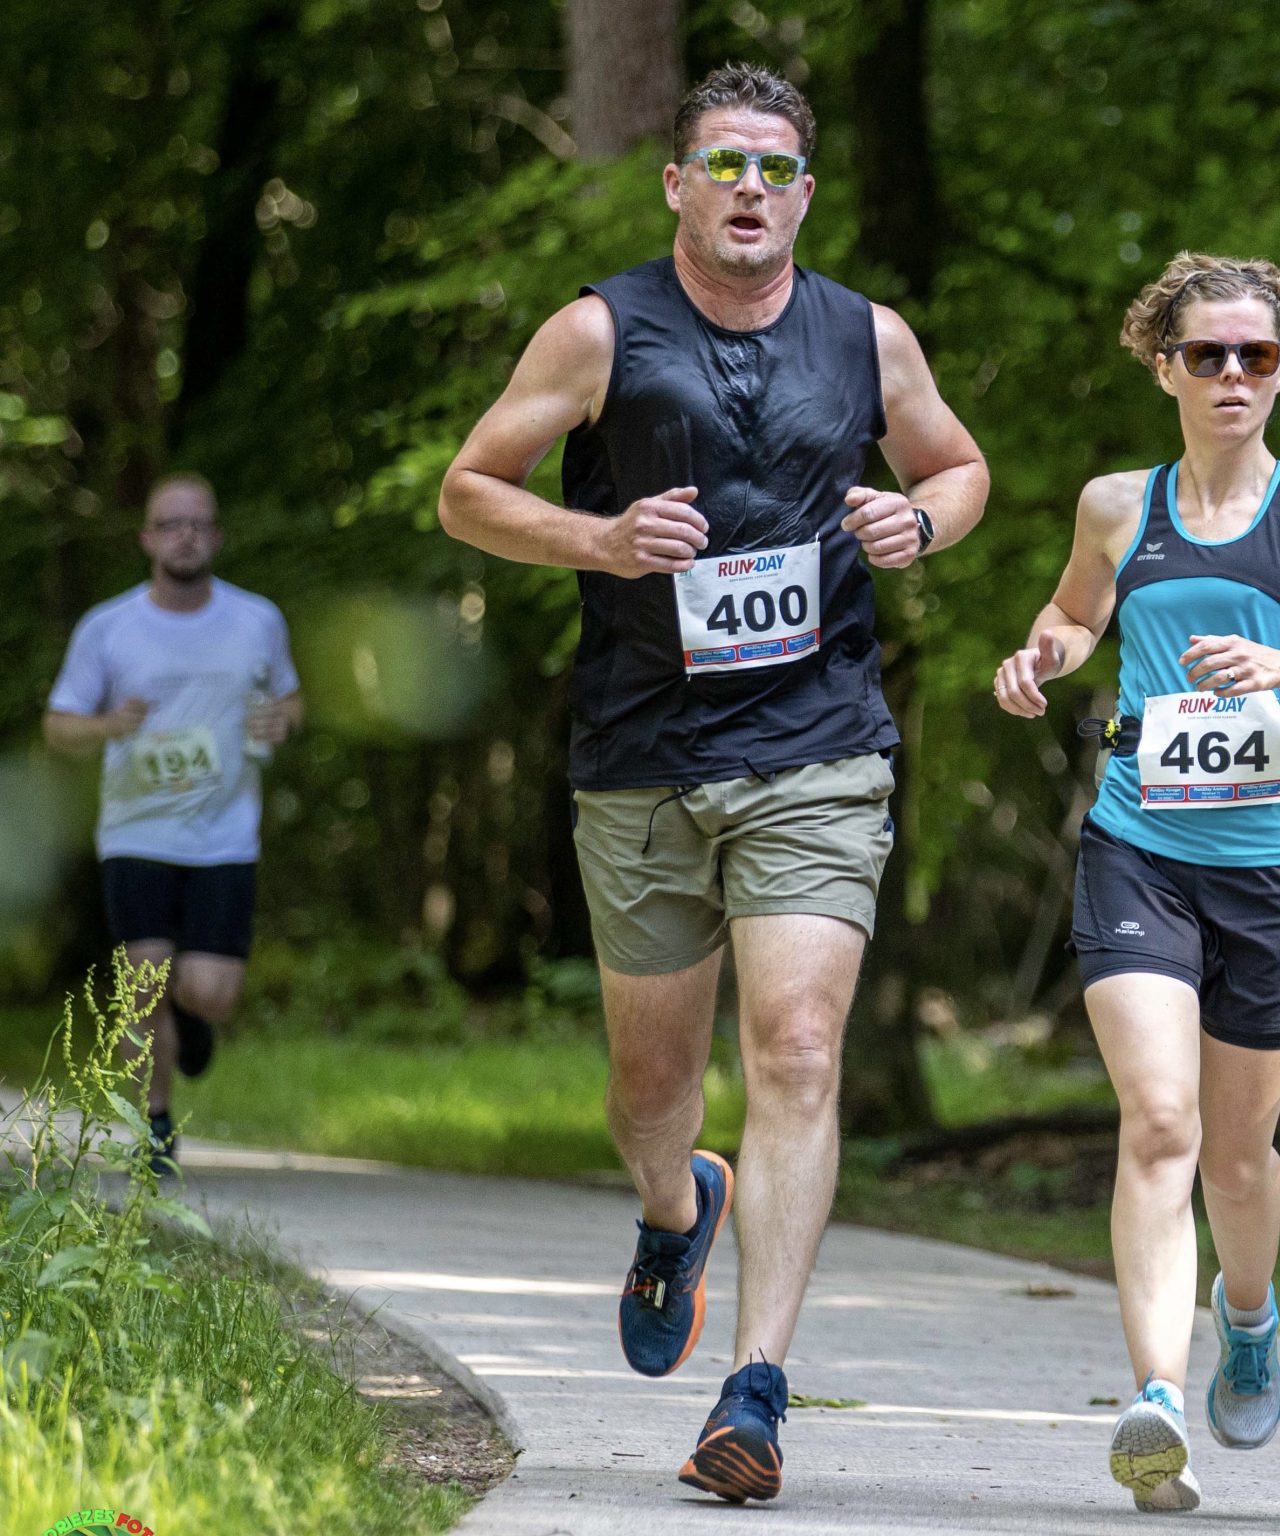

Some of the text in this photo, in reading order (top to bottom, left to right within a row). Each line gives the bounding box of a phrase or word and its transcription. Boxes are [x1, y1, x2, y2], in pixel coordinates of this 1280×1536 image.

[1137, 552, 1165, 561] erima
[706, 584, 808, 636] 400
[1160, 730, 1270, 774] 464
